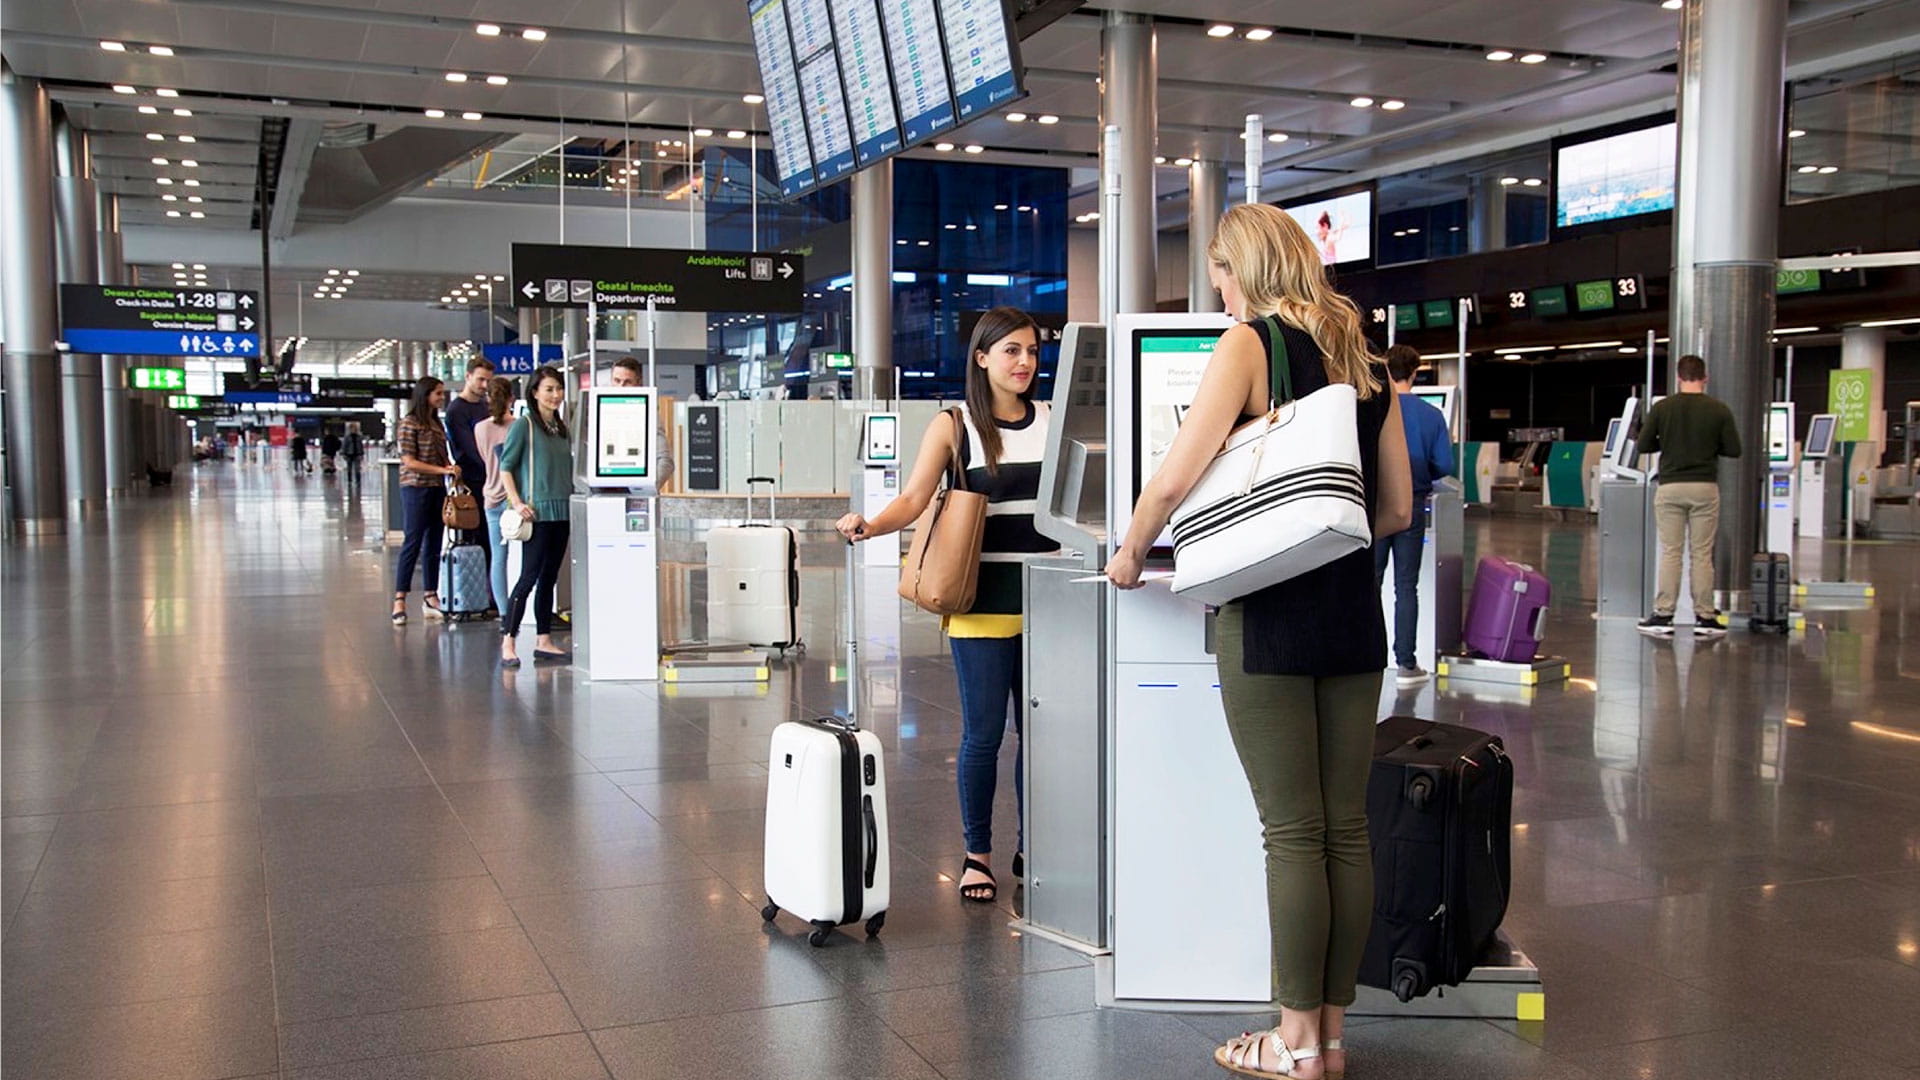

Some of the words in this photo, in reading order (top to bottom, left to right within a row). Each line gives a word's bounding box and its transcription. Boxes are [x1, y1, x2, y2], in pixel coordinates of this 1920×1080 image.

[725, 268, 747, 279] Lifts
[630, 282, 675, 292] Imeachta
[1617, 278, 1637, 296] 33
[176, 292, 216, 308] 1-28
[596, 293, 646, 304] Departure
[647, 294, 676, 304] Gates
[1509, 291, 1526, 308] 32
[1371, 307, 1386, 323] 30
